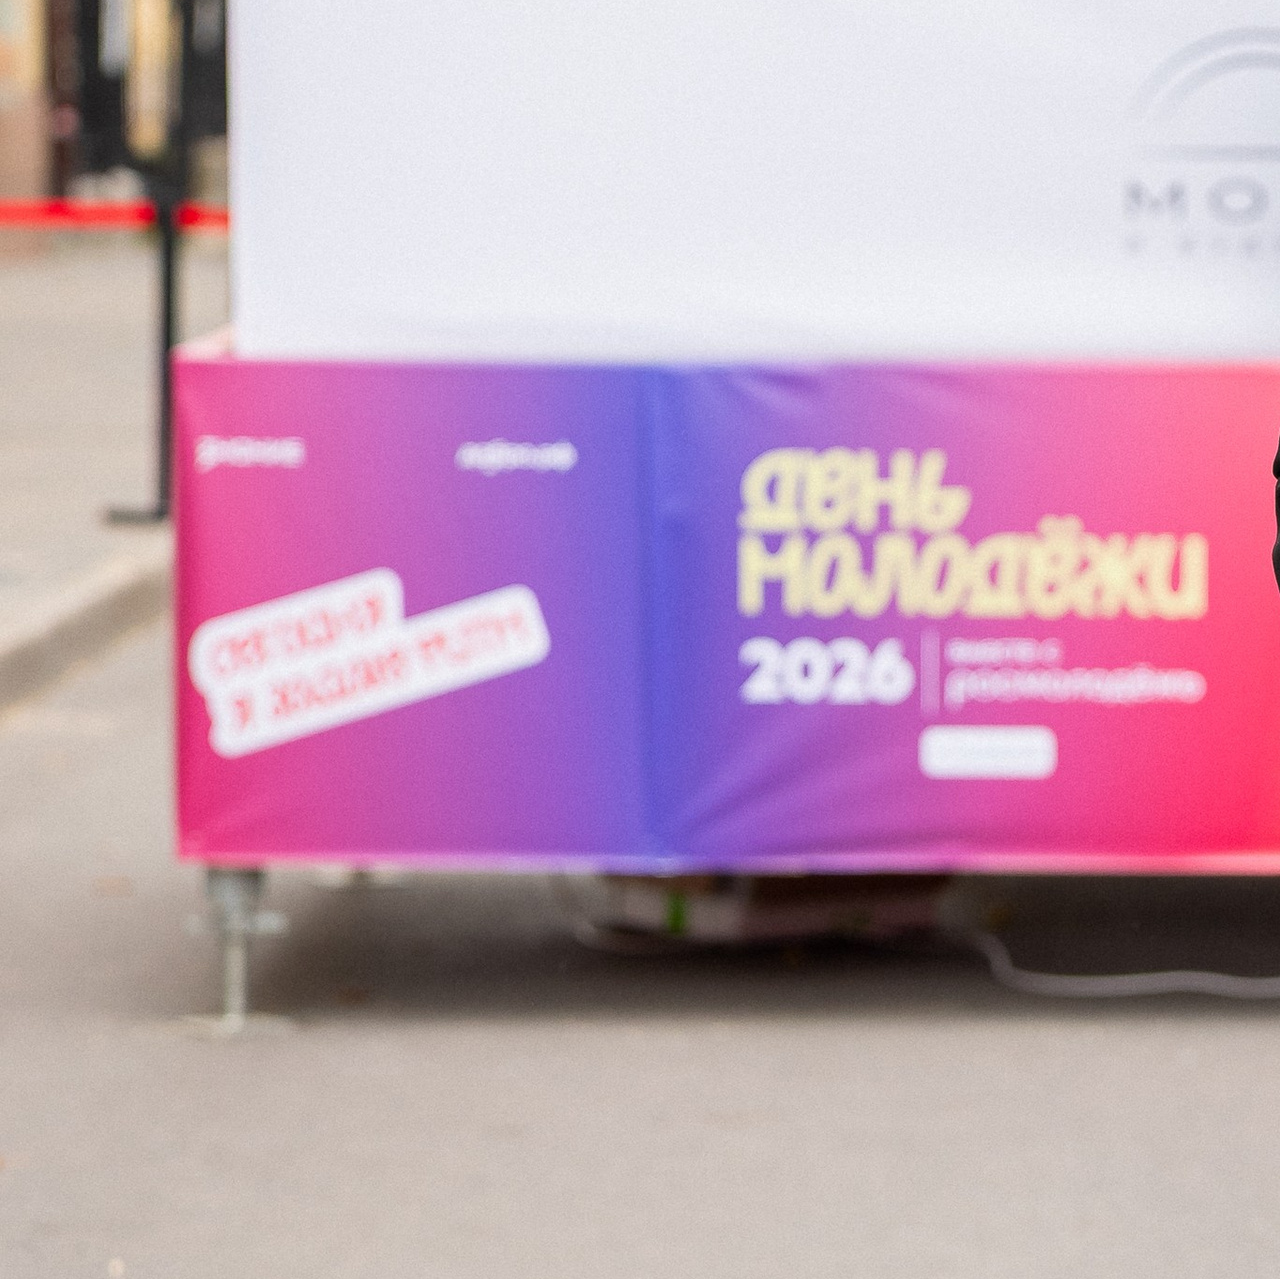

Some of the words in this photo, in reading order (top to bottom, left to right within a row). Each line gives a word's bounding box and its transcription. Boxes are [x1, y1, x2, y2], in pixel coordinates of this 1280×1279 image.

[738, 447, 971, 534] ДЕНЬ
[738, 515, 1209, 620] МОЛОДЁЖИ
[738, 636, 915, 705] 2026
